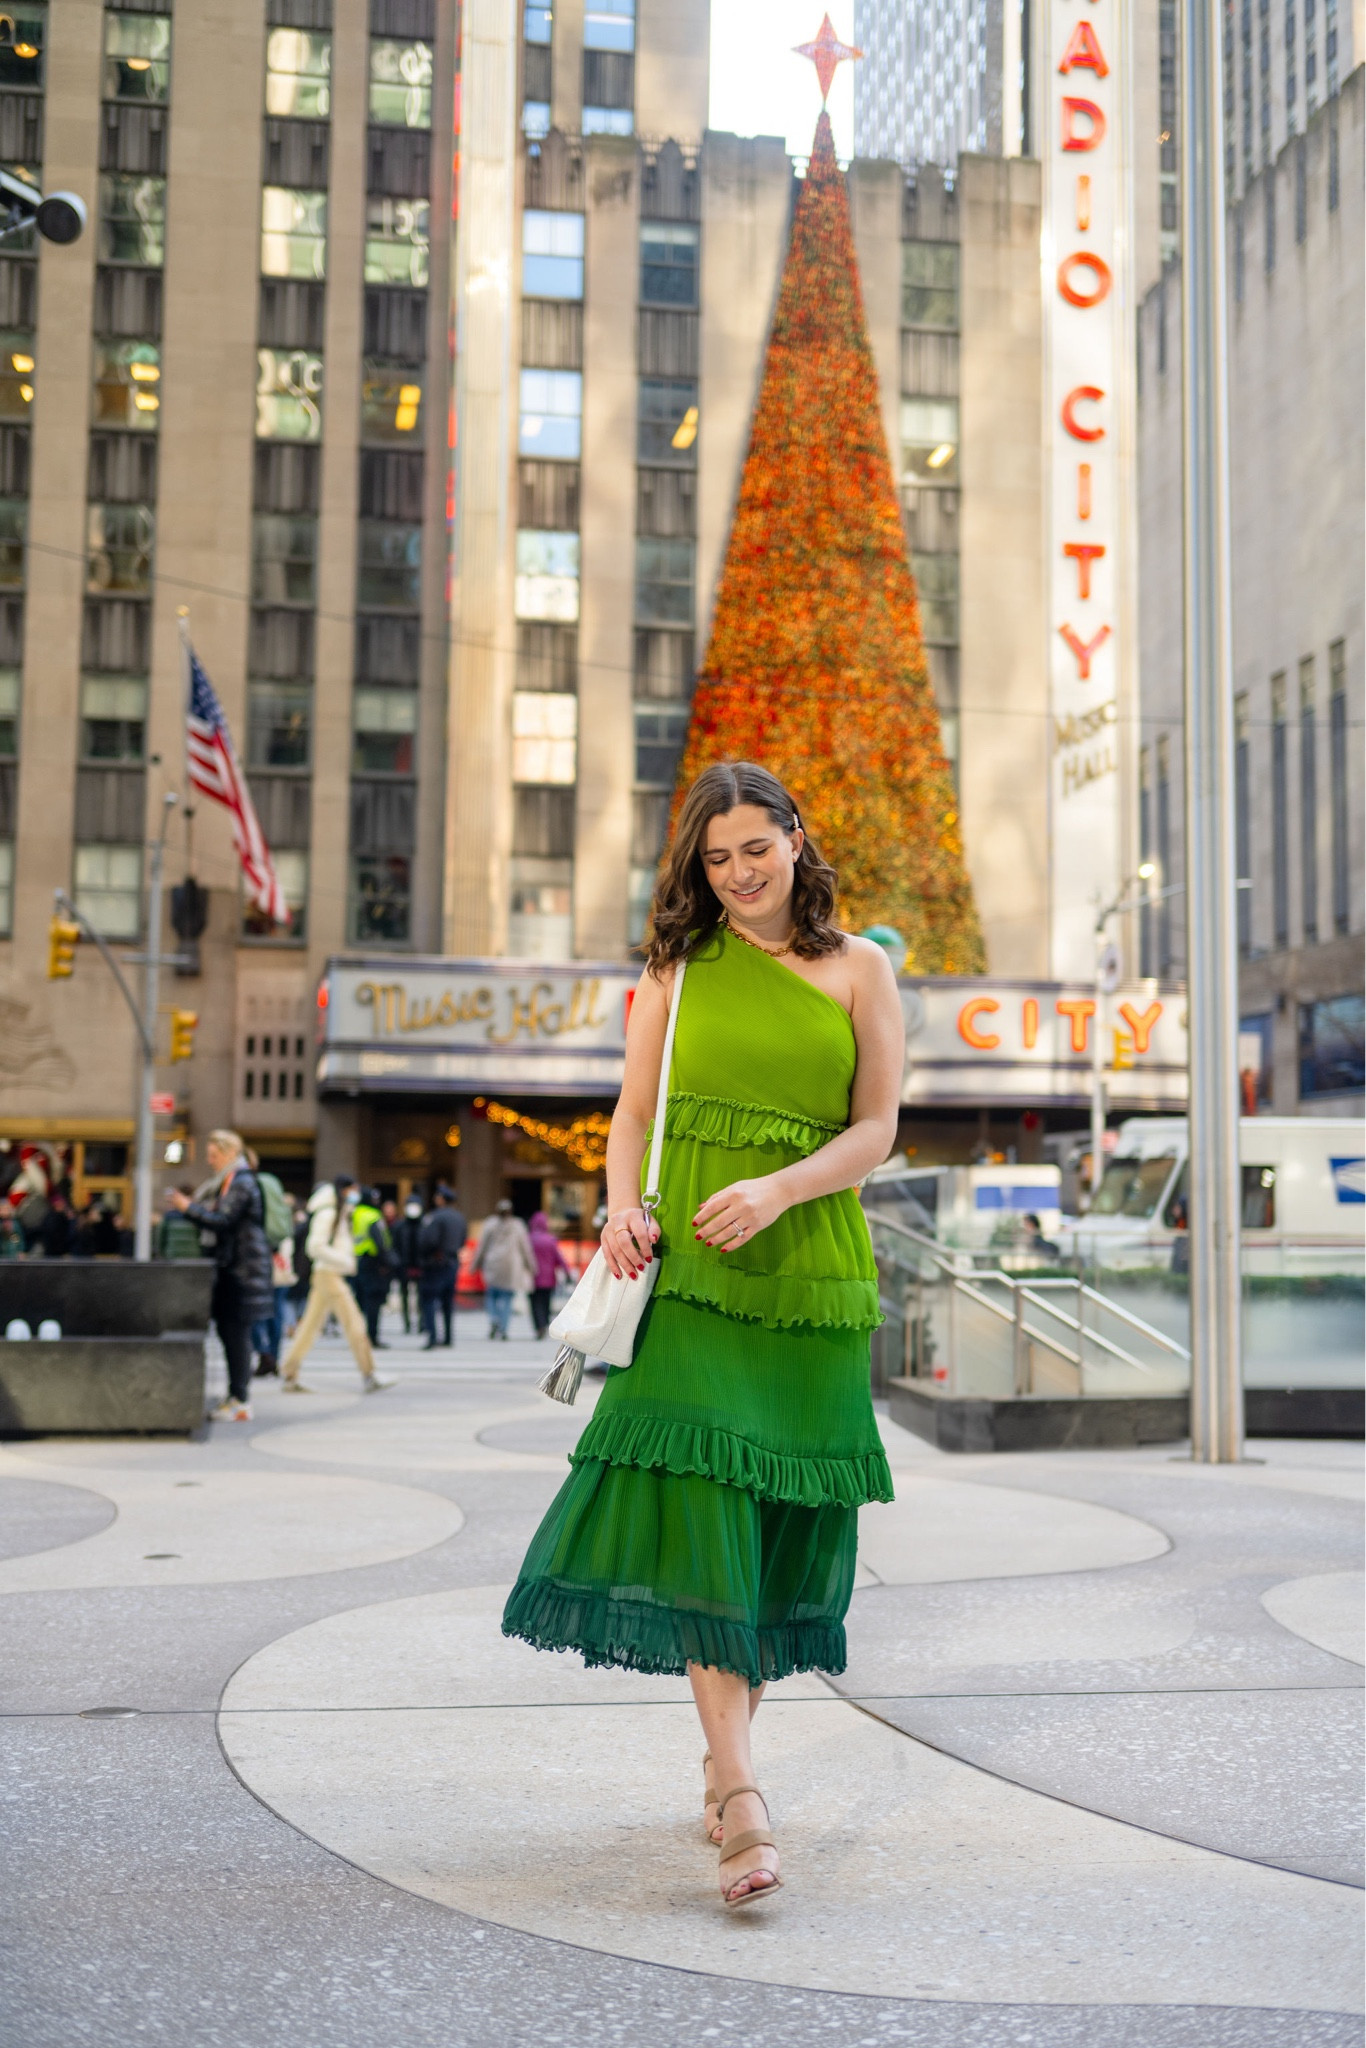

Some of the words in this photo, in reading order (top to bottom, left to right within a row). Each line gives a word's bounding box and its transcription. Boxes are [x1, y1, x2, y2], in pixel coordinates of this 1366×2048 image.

[1057, 0, 1113, 310] ADIO
[1058, 384, 1112, 680] CITY
[356, 981, 494, 1036] Music
[486, 979, 606, 1044] Hall
[957, 997, 1162, 1052] CITY
